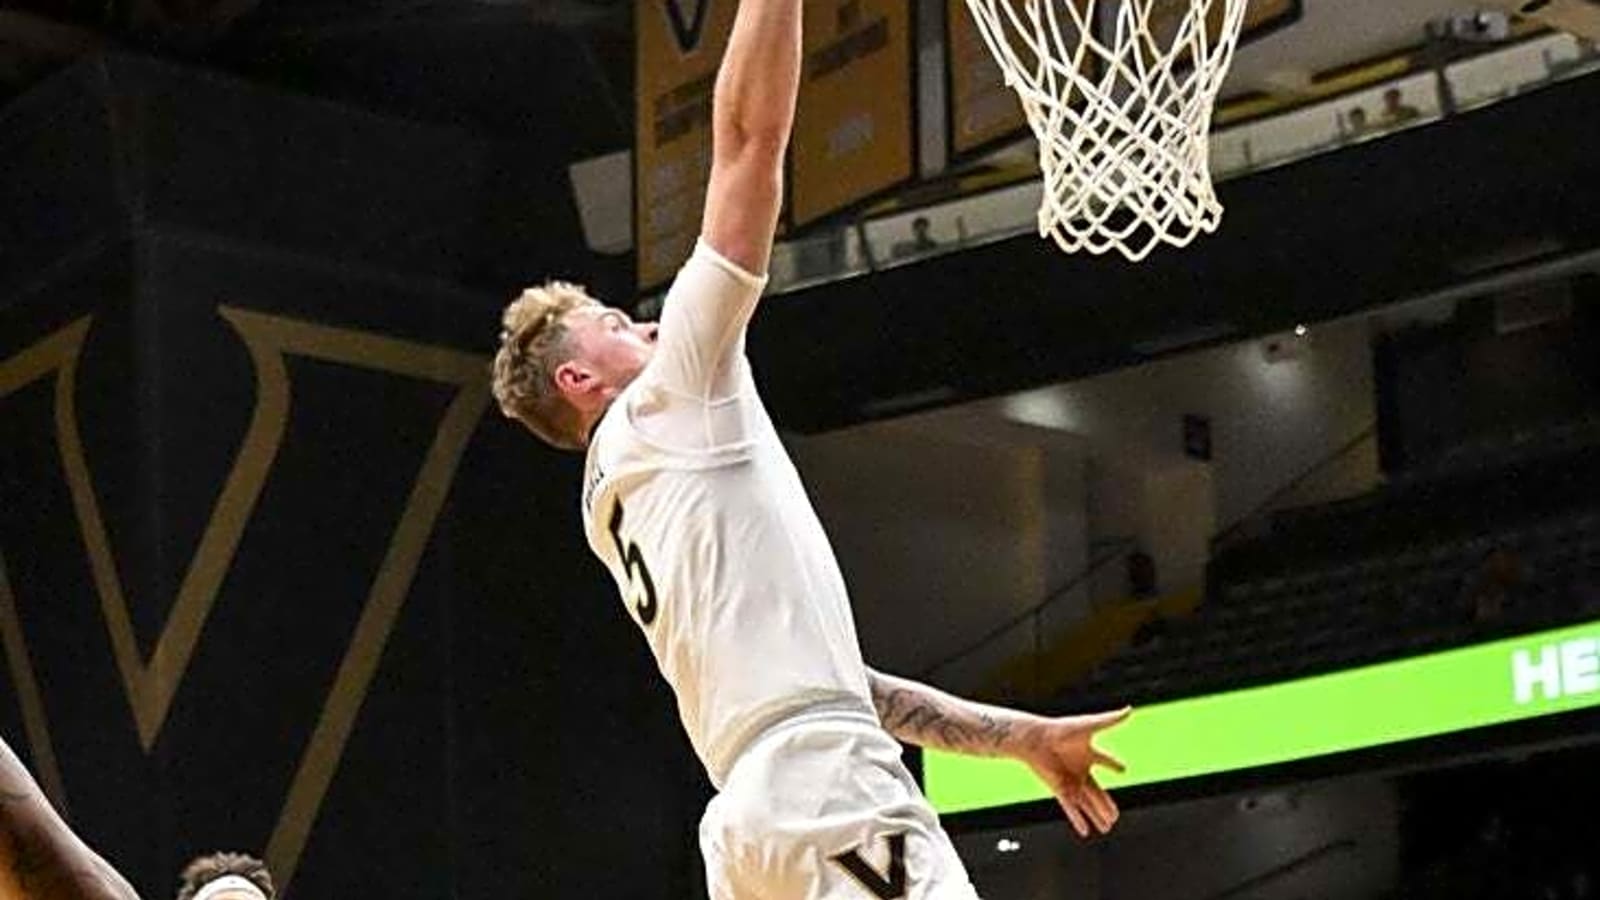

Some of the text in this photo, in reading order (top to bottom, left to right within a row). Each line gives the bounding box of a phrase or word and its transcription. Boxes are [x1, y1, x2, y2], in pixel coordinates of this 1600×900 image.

[608, 492, 658, 626] 5
[1512, 636, 1600, 705] HE
[828, 829, 908, 900] V
